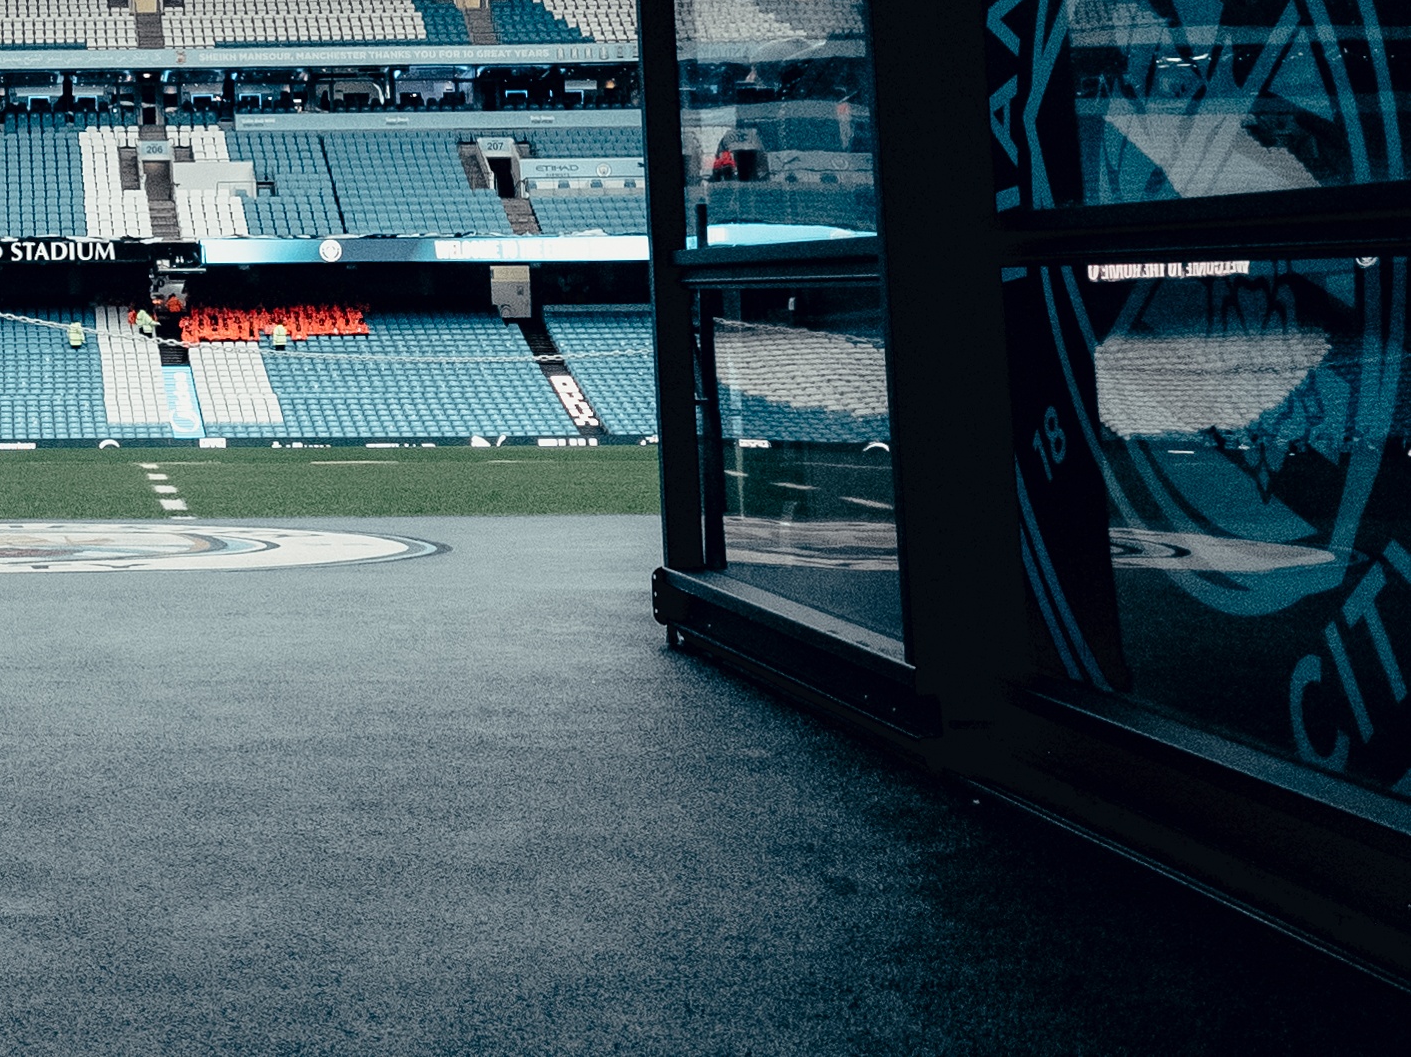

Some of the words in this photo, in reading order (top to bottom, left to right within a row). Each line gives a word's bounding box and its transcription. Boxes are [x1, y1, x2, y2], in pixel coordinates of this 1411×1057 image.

[199, 52, 237, 62] SHEIKH
[296, 51, 367, 61] MANCHESTER
[368, 50, 412, 60] THANKS
[414, 49, 437, 59] YOU
[439, 49, 461, 59] FOR
[463, 49, 474, 59] 10
[476, 48, 513, 58] GREAT
[515, 48, 550, 58] YEARS
[146, 145, 163, 154] 206
[486, 142, 504, 151] 207
[535, 164, 579, 172] ETIHAD
[10, 242, 116, 261] STADIUM
[1032, 405, 1067, 484] 18
